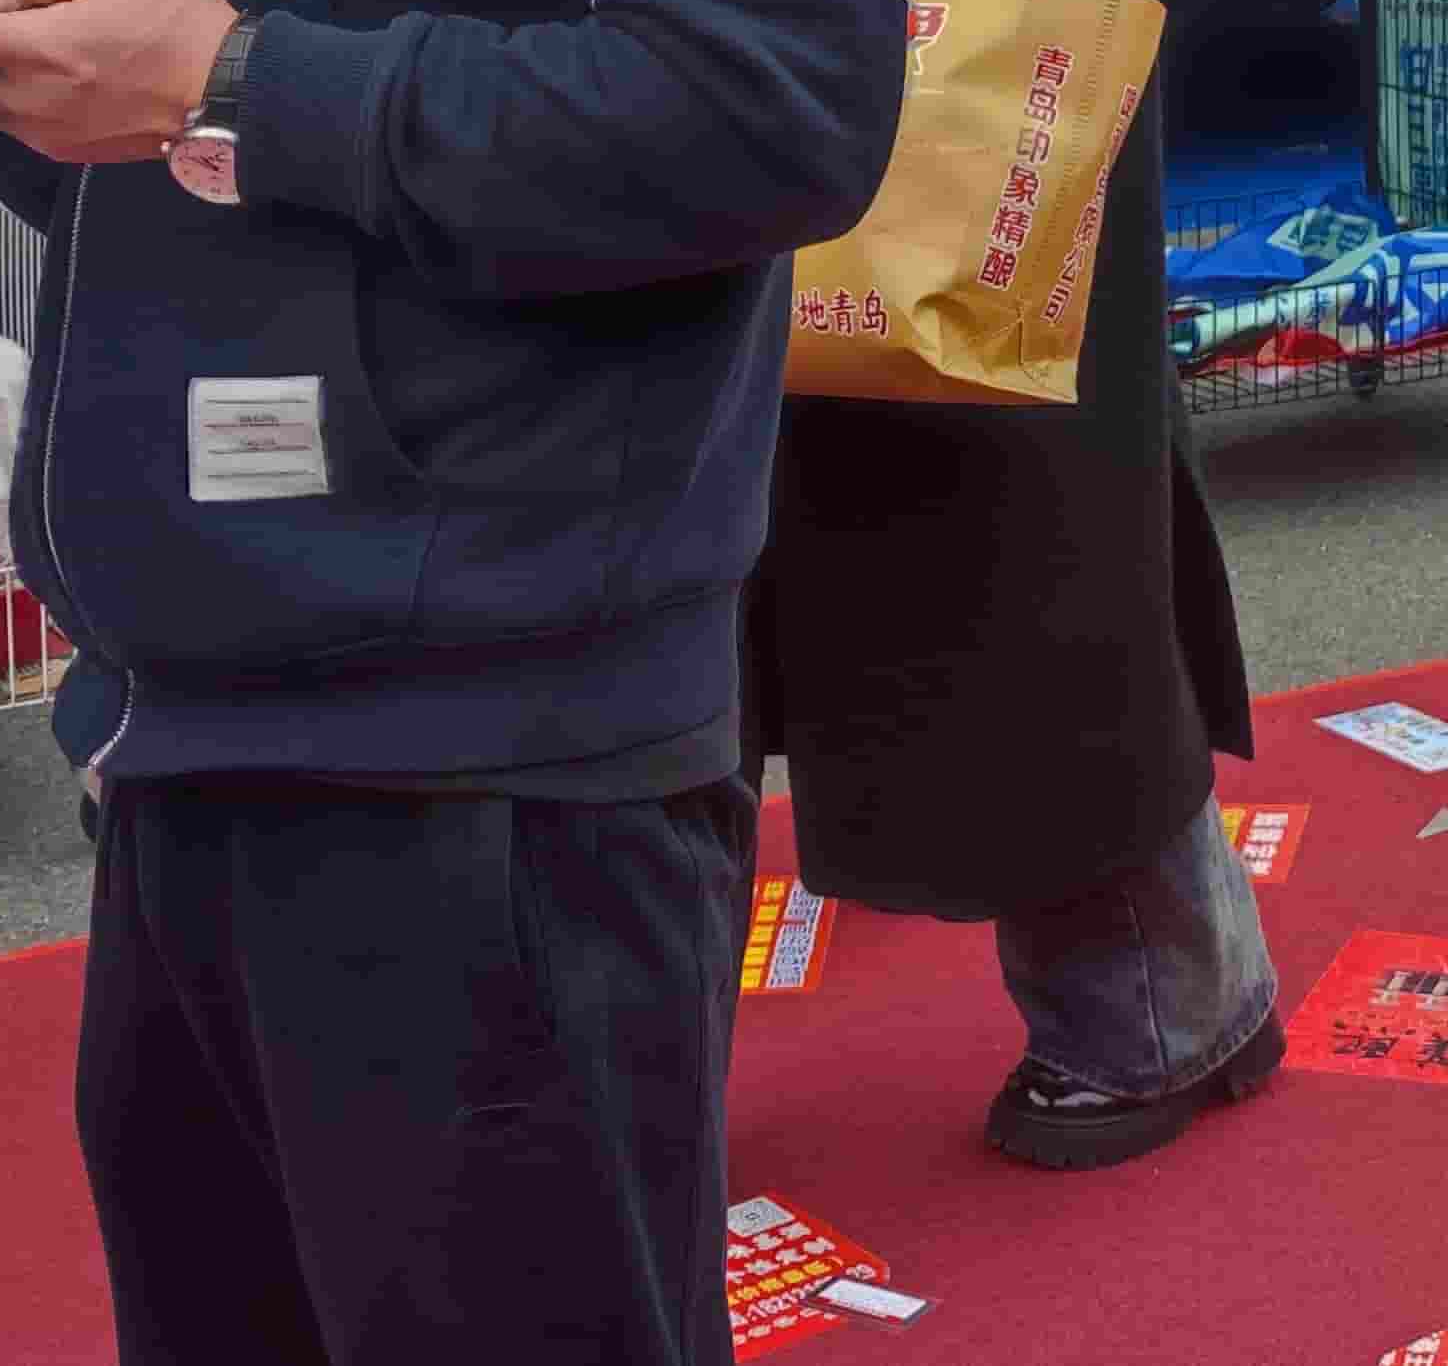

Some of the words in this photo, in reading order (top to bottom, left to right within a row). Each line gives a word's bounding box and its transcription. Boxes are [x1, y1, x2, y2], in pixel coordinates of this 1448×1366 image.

[978, 44, 1075, 289] 青岛印象精酿
